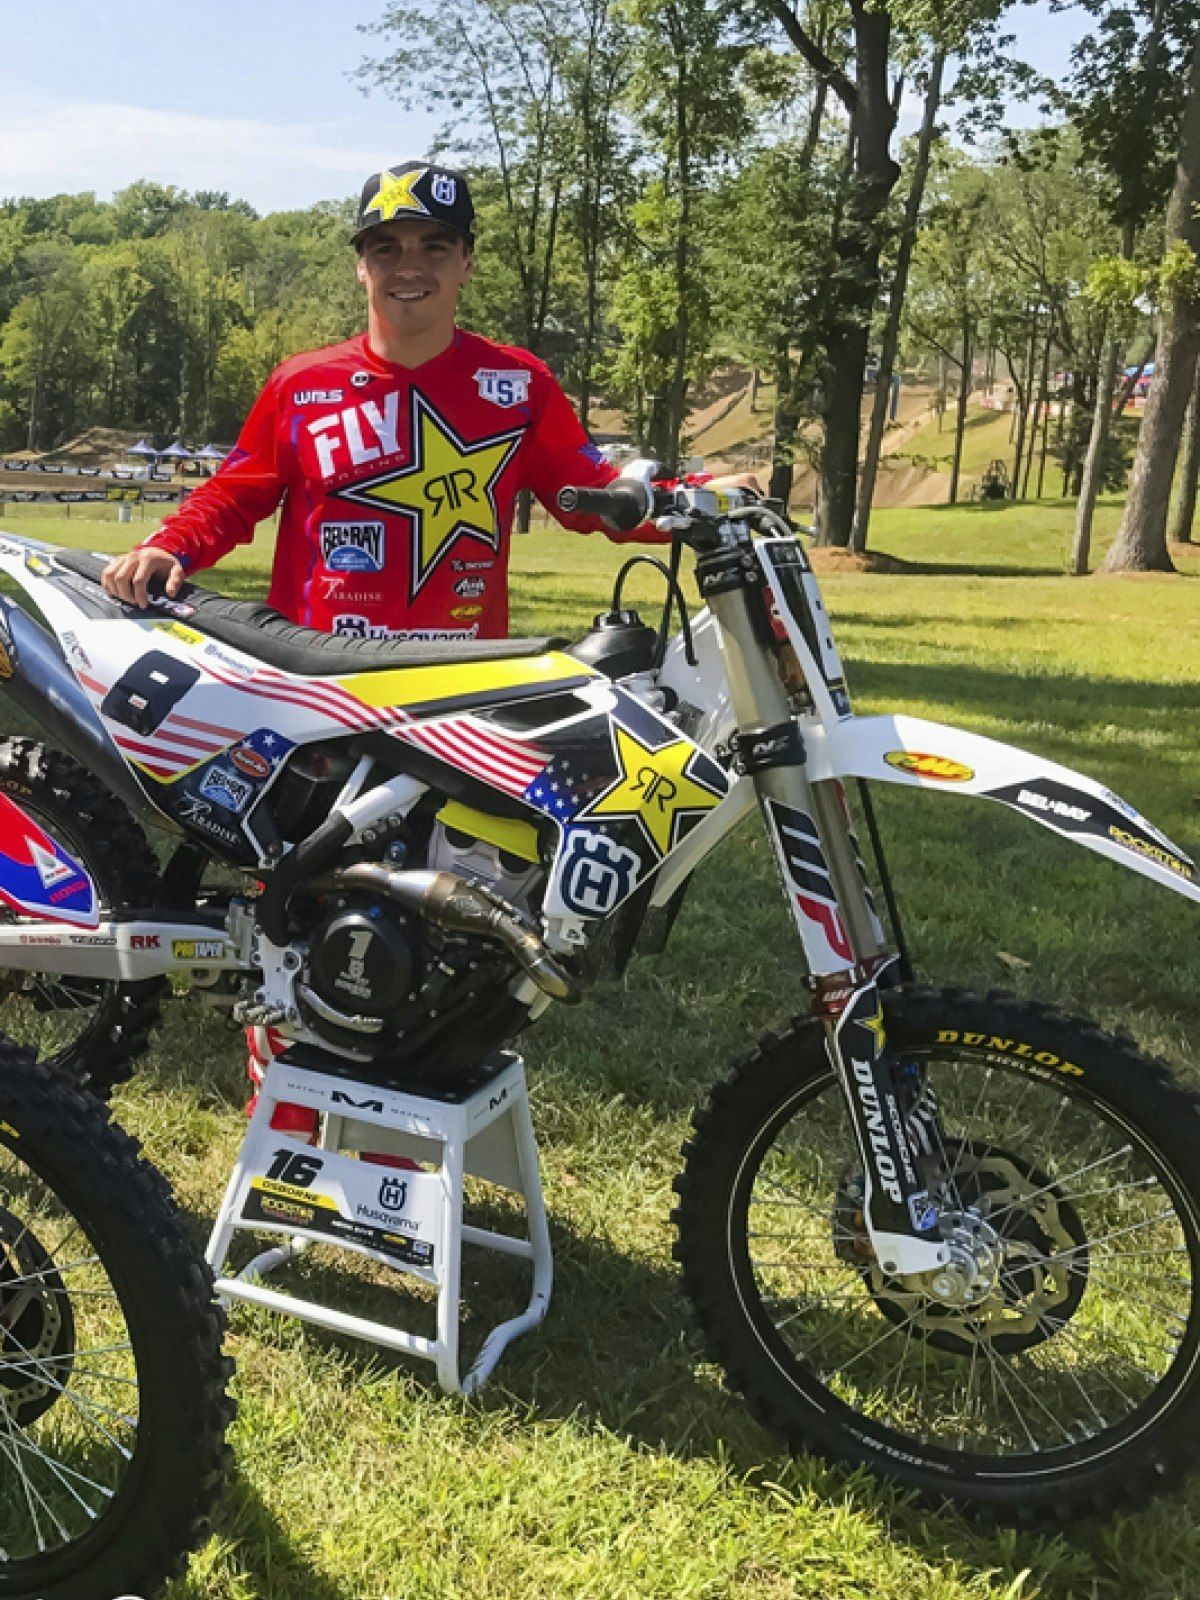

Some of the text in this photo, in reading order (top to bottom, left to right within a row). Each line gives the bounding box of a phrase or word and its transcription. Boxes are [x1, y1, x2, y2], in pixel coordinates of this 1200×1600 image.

[482, 380, 527, 405] USA
[307, 391, 401, 479] FLY
[101, 649, 200, 736] 8
[130, 935, 160, 948] RK
[936, 1029, 1085, 1076] DUNLOP
[851, 1056, 903, 1204] DUNLOP
[265, 1148, 325, 1188] 16
[356, 1203, 421, 1231] Husqvarna
